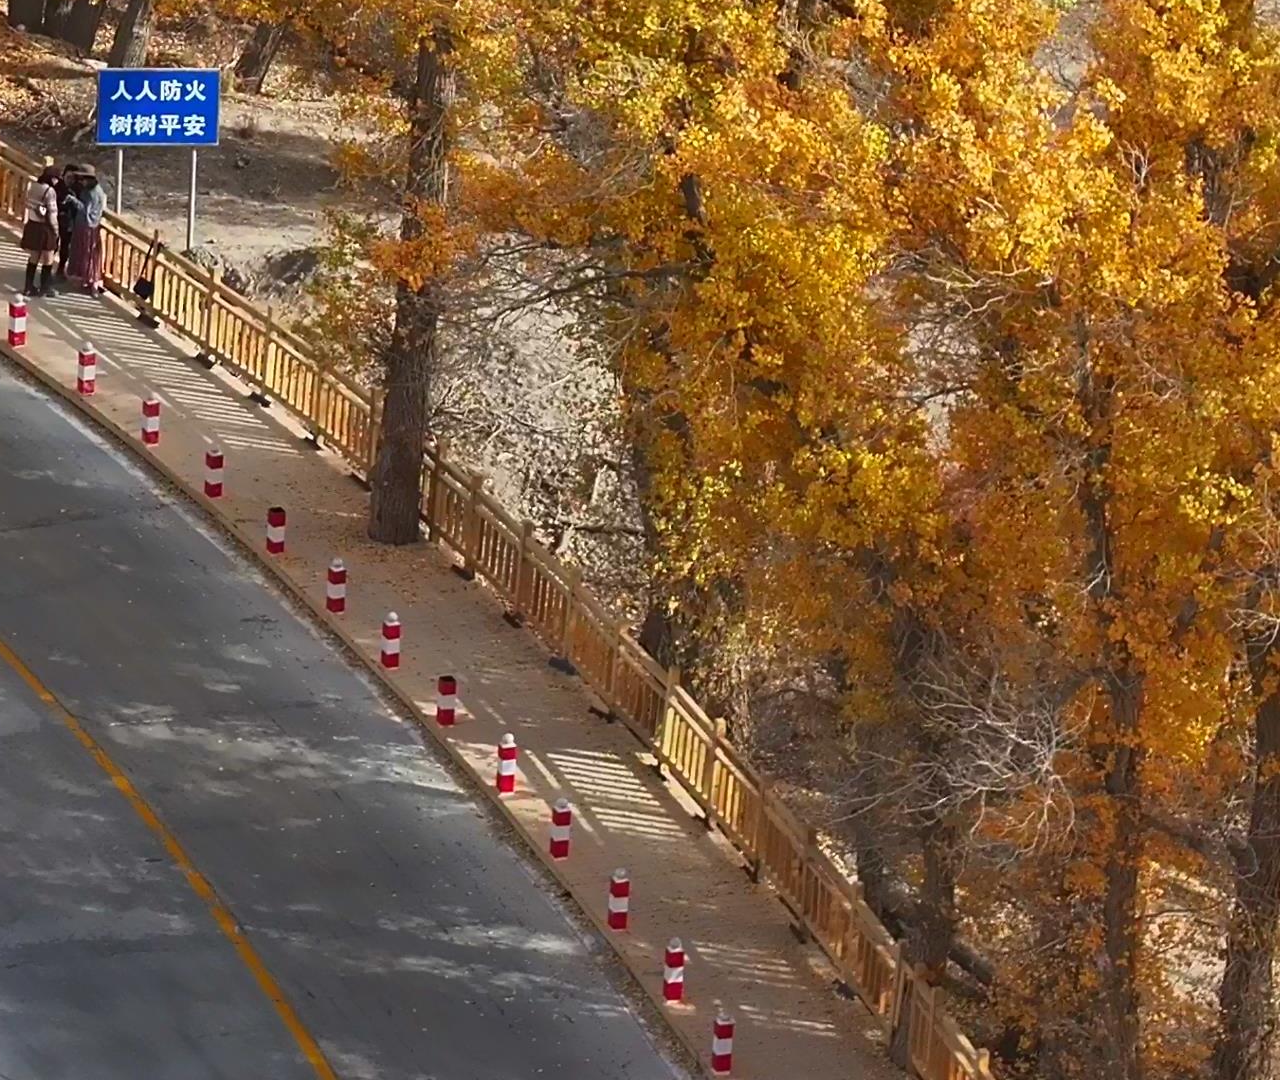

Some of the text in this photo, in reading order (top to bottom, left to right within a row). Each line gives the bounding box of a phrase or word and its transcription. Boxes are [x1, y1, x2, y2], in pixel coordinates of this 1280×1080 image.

[110, 79, 207, 101] 人人防火
[109, 114, 206, 137] 树树平安
